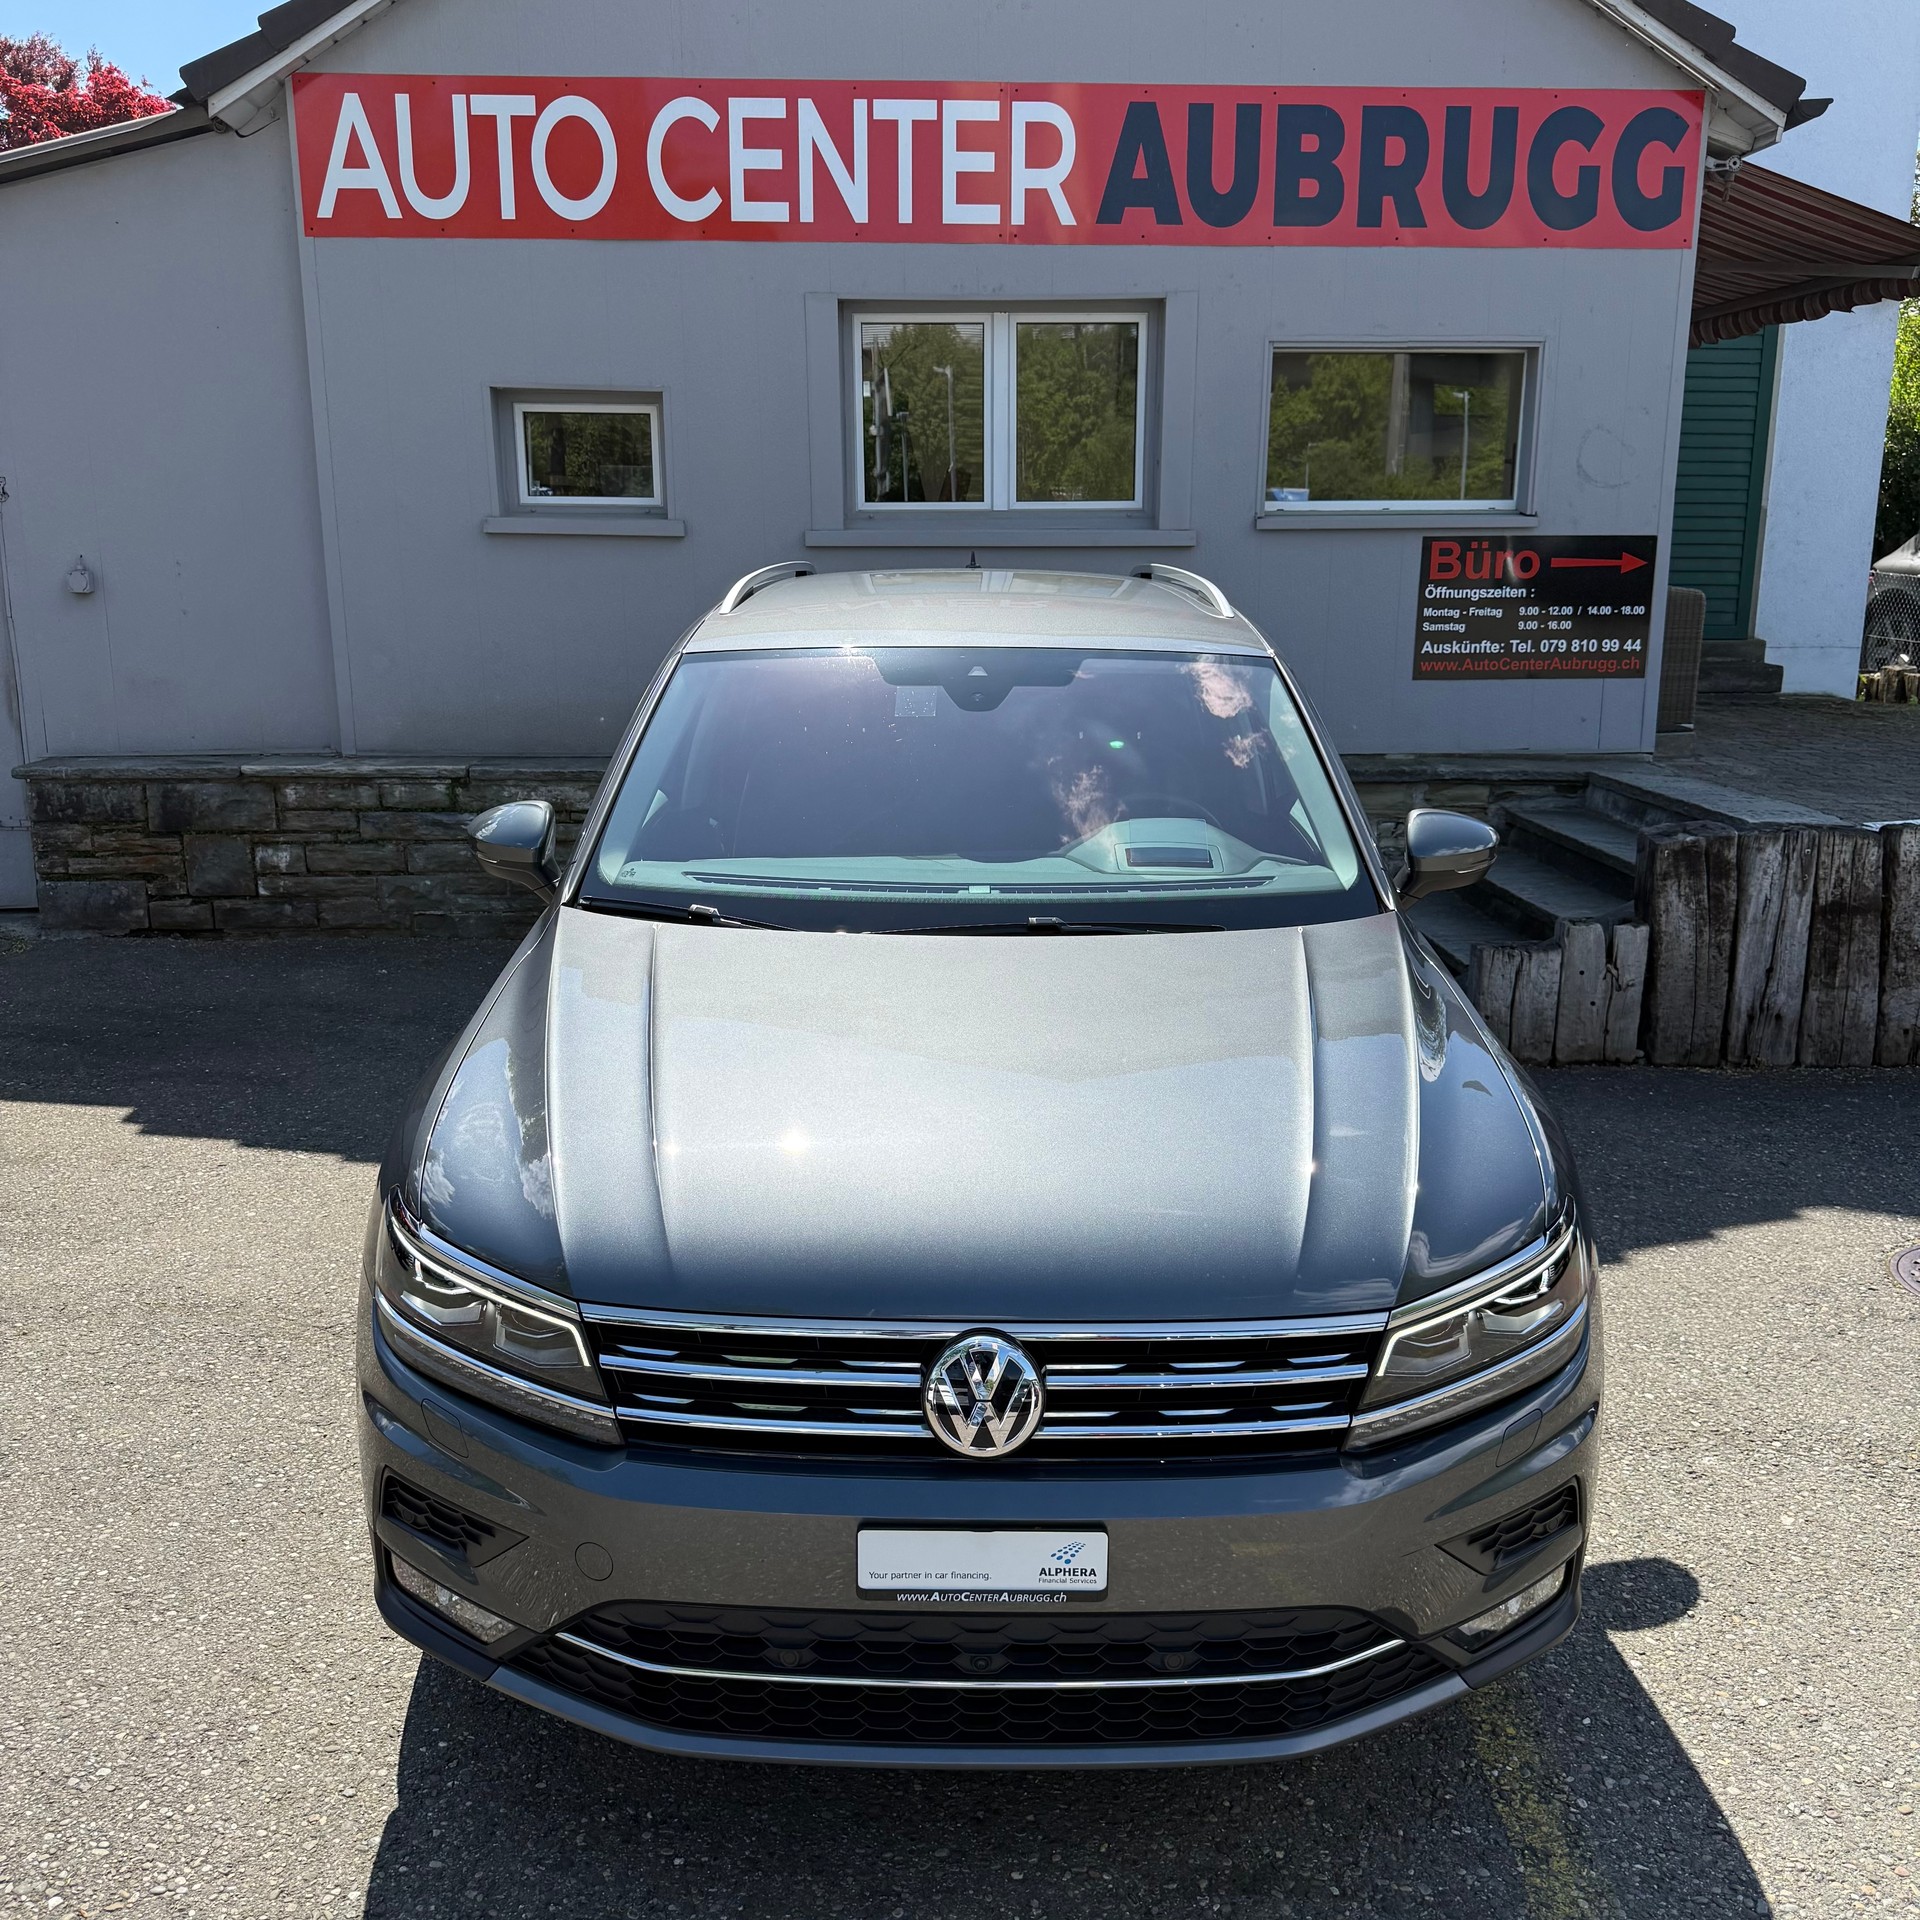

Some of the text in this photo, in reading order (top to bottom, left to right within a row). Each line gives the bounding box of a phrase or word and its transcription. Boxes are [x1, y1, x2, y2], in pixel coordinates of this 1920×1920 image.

[317, 92, 1691, 232] AUTO CENTER AUBRUGG
[1429, 541, 1541, 581] Büro
[1425, 584, 1527, 601] Öffnungszeiten
[1423, 607, 1460, 619] Montag
[1468, 606, 1503, 618] Freitag
[1519, 606, 1539, 616] 9.00
[1548, 606, 1573, 616] 12.00
[1587, 605, 1612, 615] 14.00
[1620, 605, 1645, 615] 18.00
[1422, 621, 1466, 633] Samstag
[1518, 621, 1538, 630] 9.00
[1547, 620, 1572, 630] 16.00
[1421, 638, 1642, 654] Auskünfte: Tel. 079 810 99 44
[1420, 656, 1640, 673] www.AutoCenterAubrugg.ch
[869, 1571, 992, 1581] Your partner in car financing.
[1039, 1567, 1097, 1577] ALPHERA
